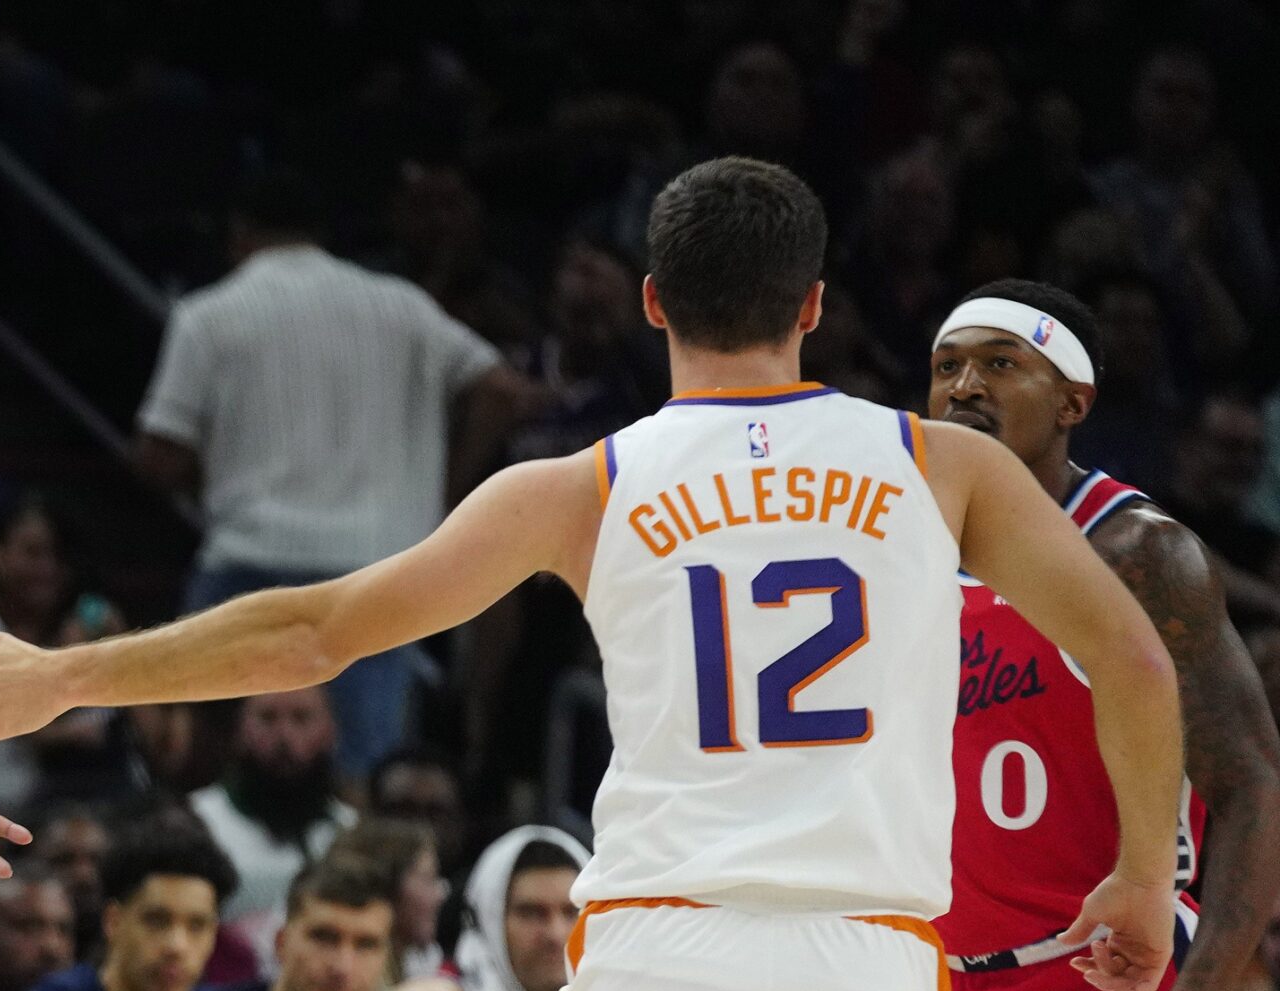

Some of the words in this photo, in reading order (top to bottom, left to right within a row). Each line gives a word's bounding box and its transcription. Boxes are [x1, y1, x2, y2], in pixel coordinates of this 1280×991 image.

[628, 467, 905, 558] GILLESPIE
[683, 557, 874, 753] 12
[958, 647, 1047, 717] eles
[980, 740, 1048, 831] 0
